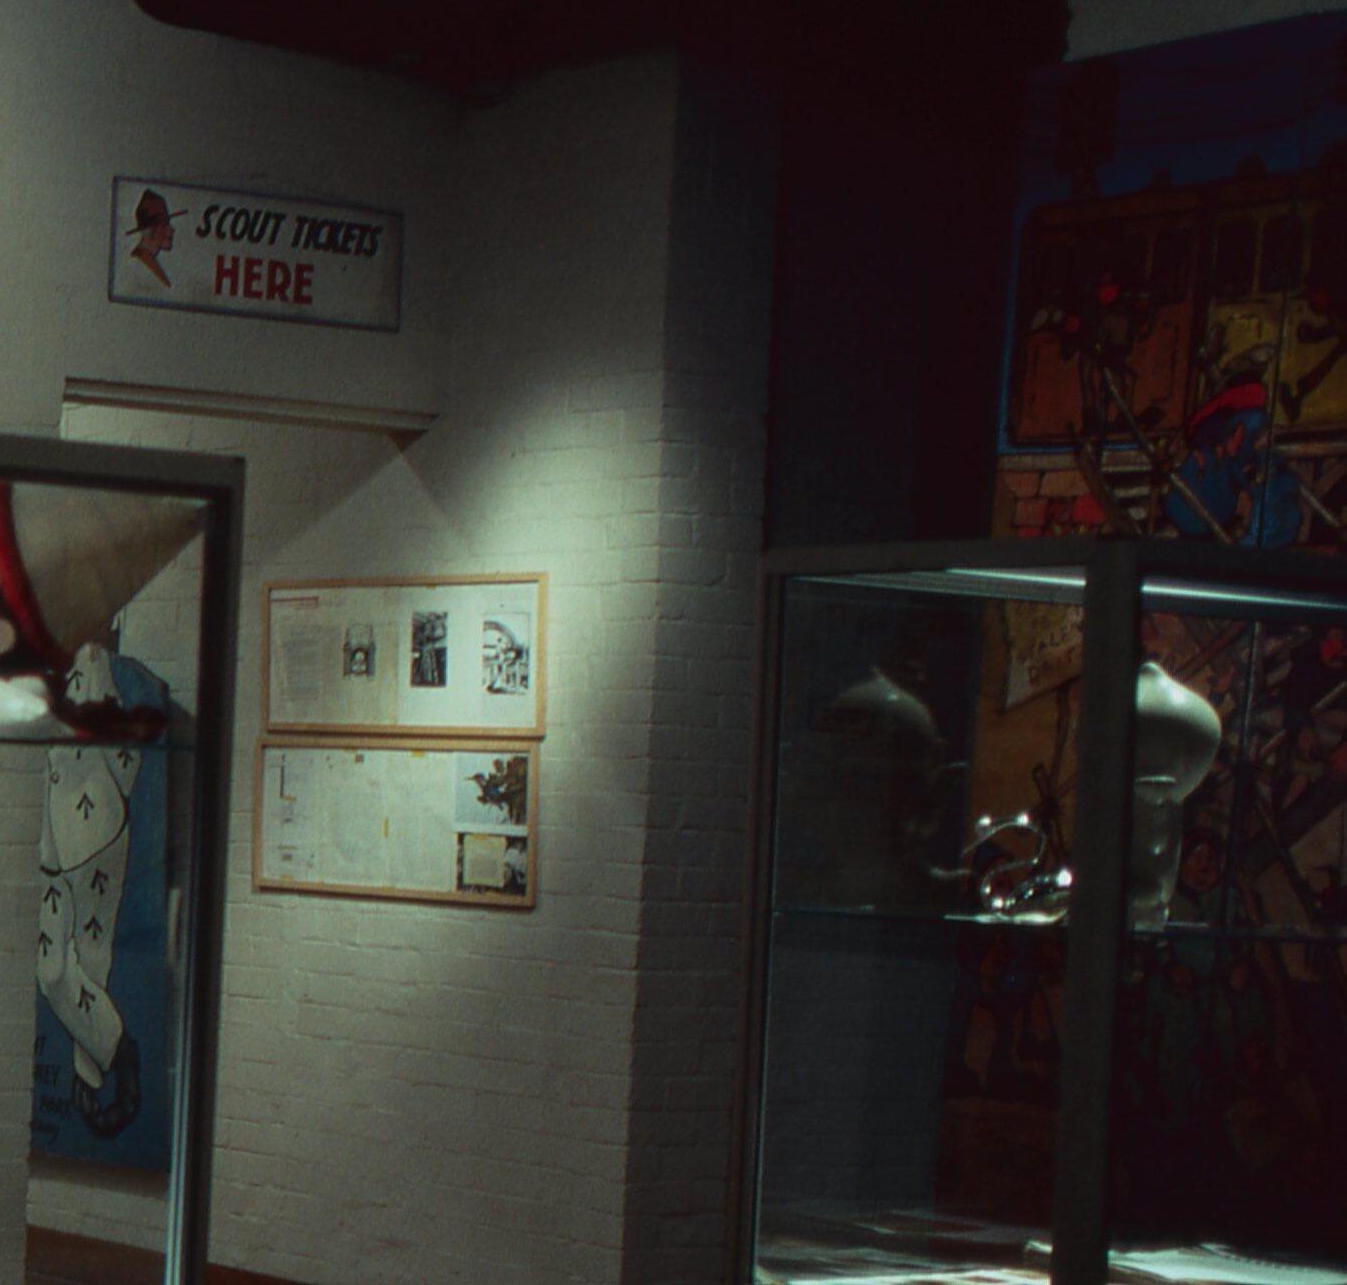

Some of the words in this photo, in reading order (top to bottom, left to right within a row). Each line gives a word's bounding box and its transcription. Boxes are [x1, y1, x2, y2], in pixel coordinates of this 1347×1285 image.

[196, 204, 286, 246] SCOUT
[291, 216, 384, 257] TICKETS
[215, 253, 315, 305] HERE
